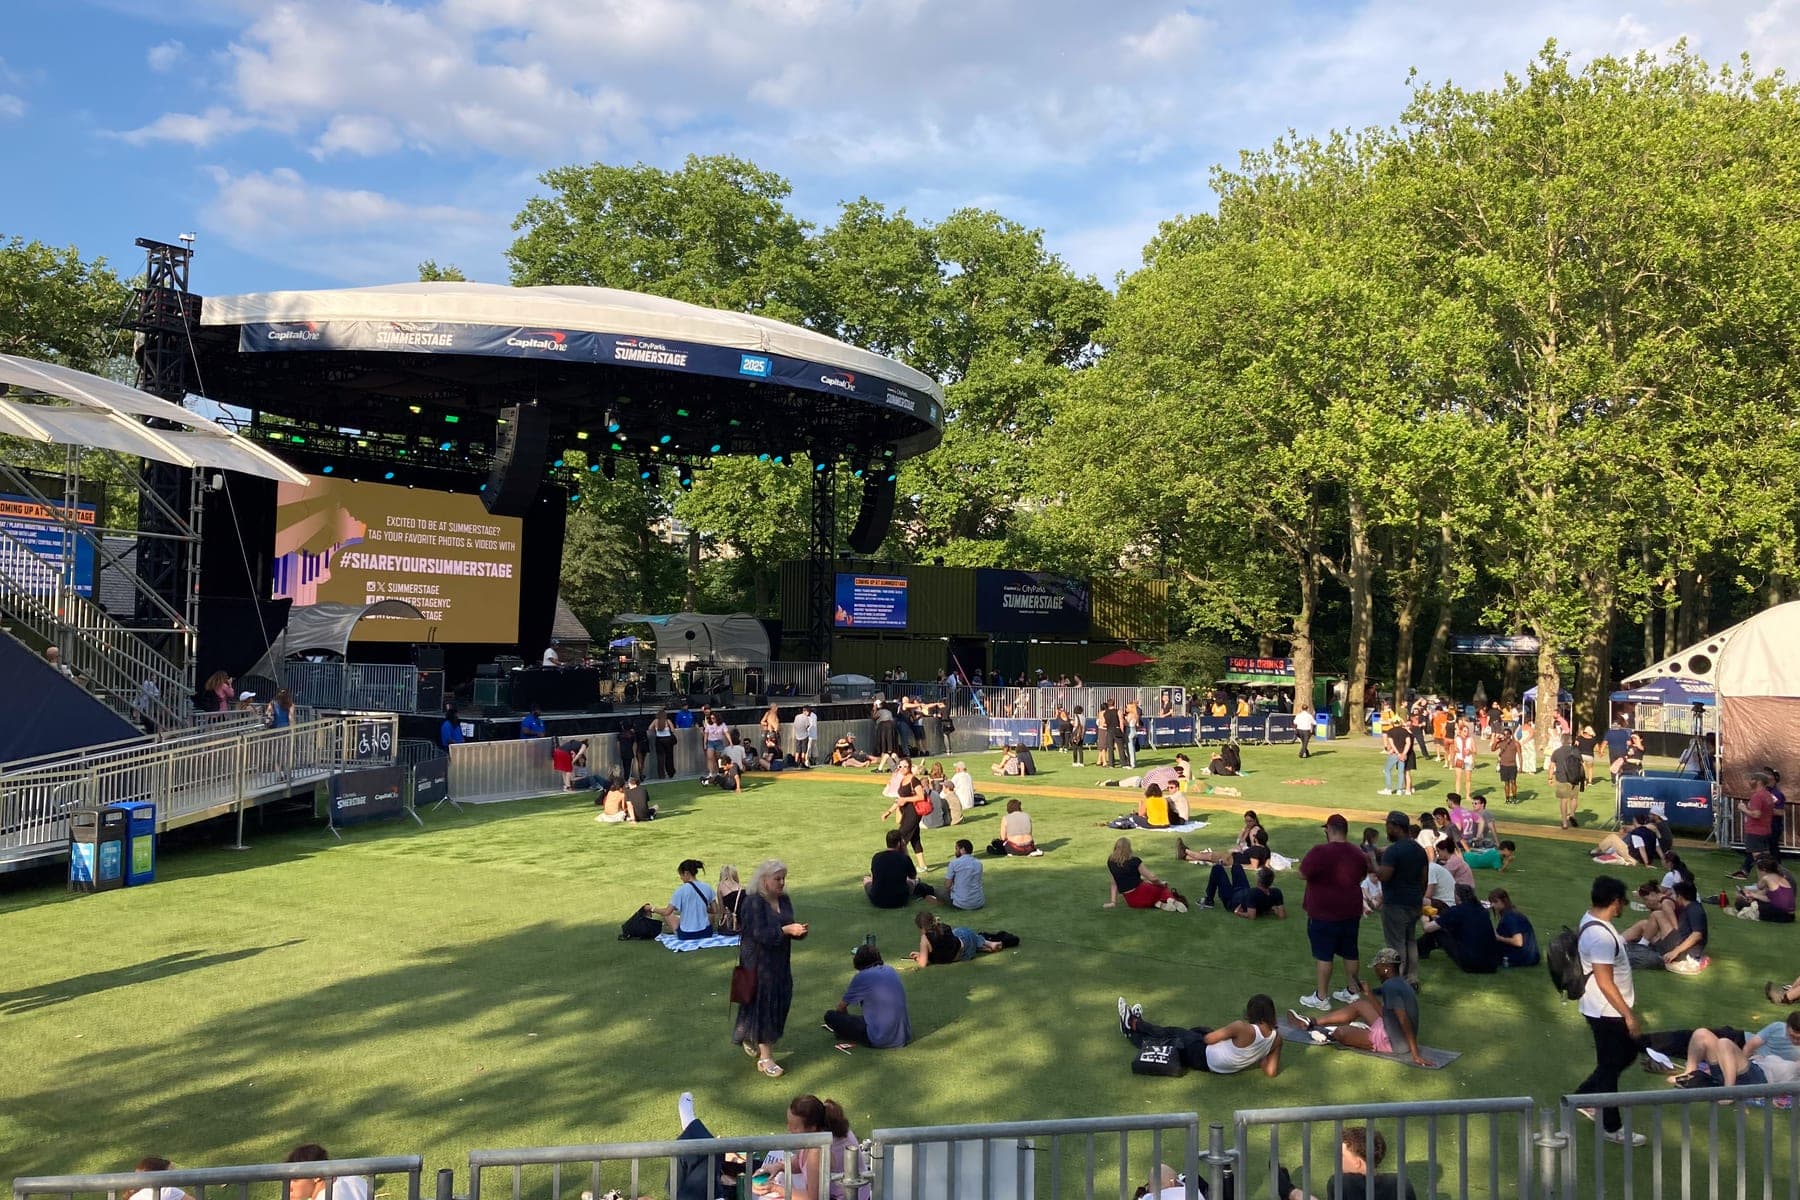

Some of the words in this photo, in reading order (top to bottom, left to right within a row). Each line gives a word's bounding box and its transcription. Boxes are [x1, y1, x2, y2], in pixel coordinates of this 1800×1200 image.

[376, 331, 453, 346] SUMMERSTAGE
[615, 347, 688, 367] SUMMERSTAGE
[743, 358, 765, 372] 2025
[24, 505, 33, 514] UP
[35, 507, 44, 516] AT
[387, 515, 415, 529] EXCITED
[417, 519, 426, 529] TO
[428, 520, 437, 530] BE
[439, 521, 447, 531] AT
[448, 522, 500, 537] SUMMERSTAGE?
[368, 529, 381, 541] TAG
[383, 530, 403, 542] YOUR
[404, 532, 437, 545] FAVORITE
[438, 535, 465, 548] PHOTOS
[466, 538, 473, 548] &
[475, 539, 498, 550] VIDEOS
[499, 541, 516, 552] WITH
[340, 552, 512, 578] #SHAREYOURSUMMERSTAGE
[388, 583, 440, 595] SUMMERSTAGE
[1003, 594, 1063, 609] SUMMERSTAGE
[1257, 659, 1284, 669] DRINKS
